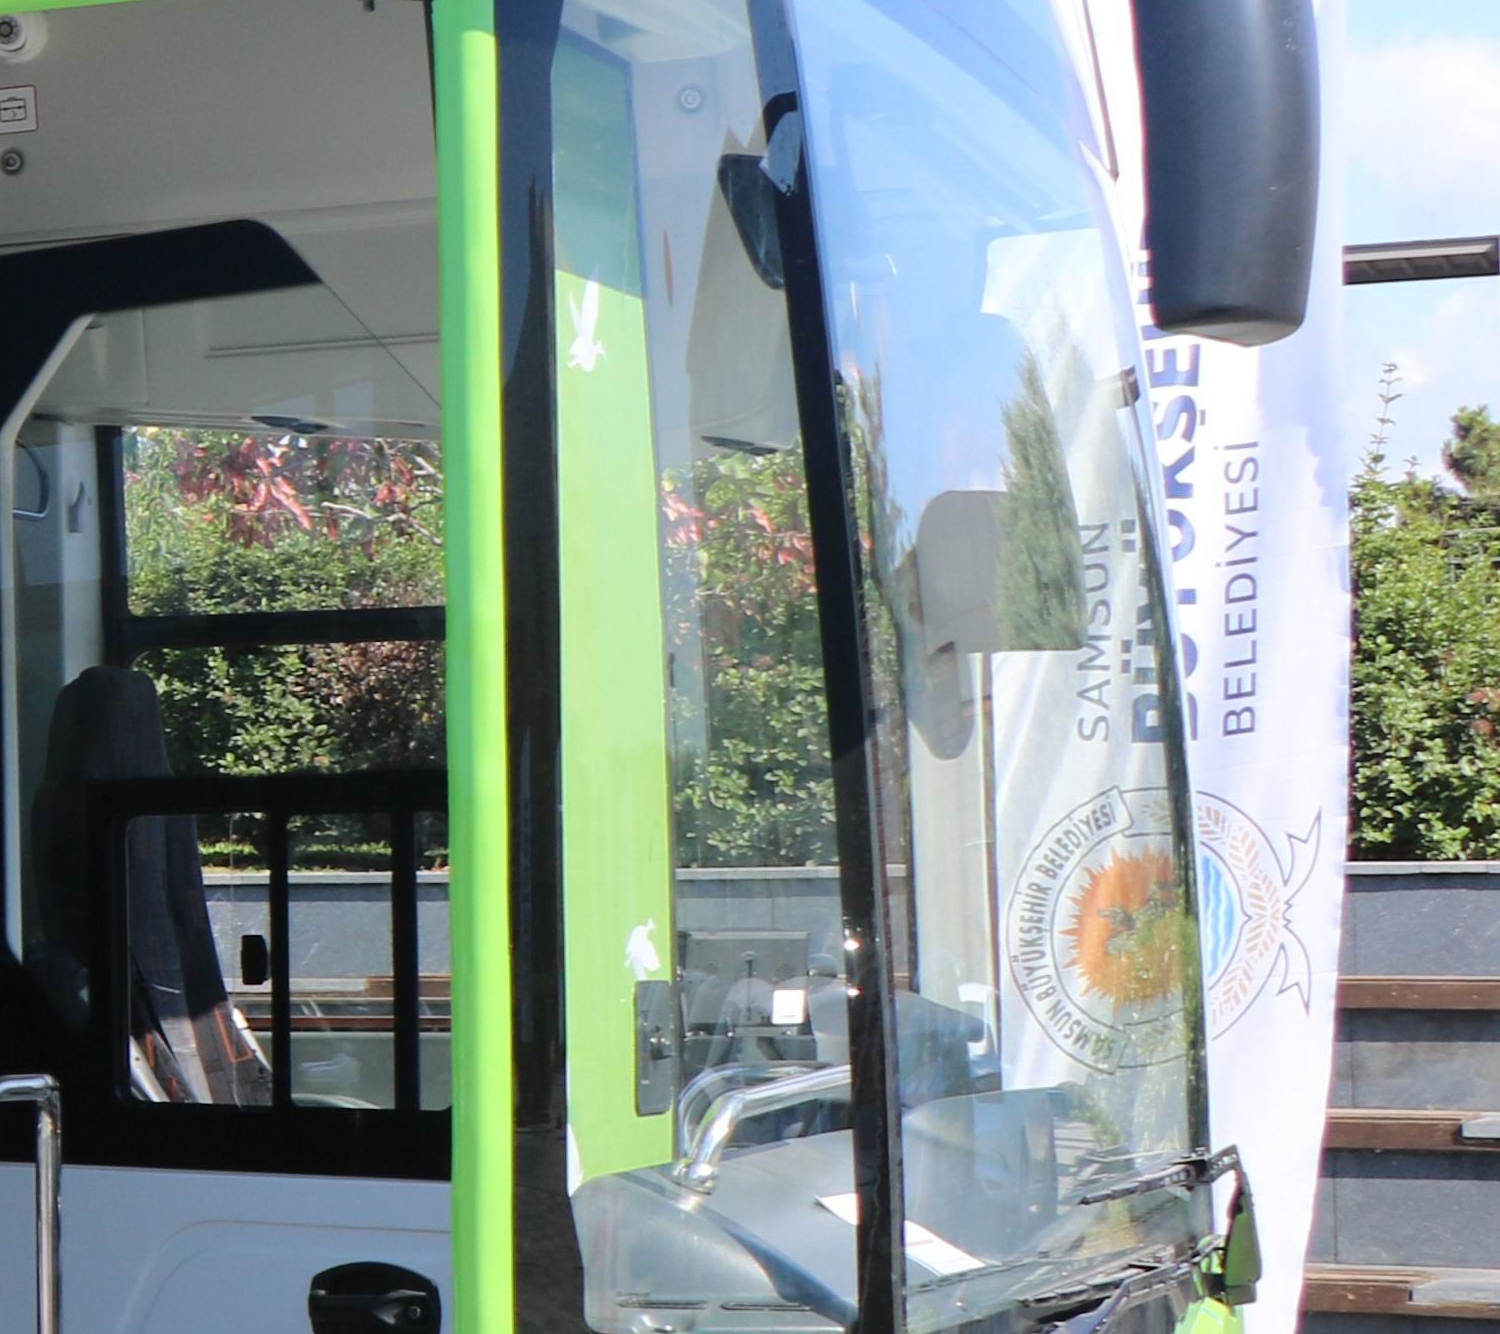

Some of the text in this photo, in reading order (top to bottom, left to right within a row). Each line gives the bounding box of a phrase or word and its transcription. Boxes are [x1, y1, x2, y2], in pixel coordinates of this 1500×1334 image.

[1076, 521, 1111, 743] SAMSUN
[1215, 440, 1260, 737] BELEDİYESİ
[1011, 881, 1056, 1002] BÜYÜKŞEHİR
[1036, 794, 1117, 880] BELEDİYESİ
